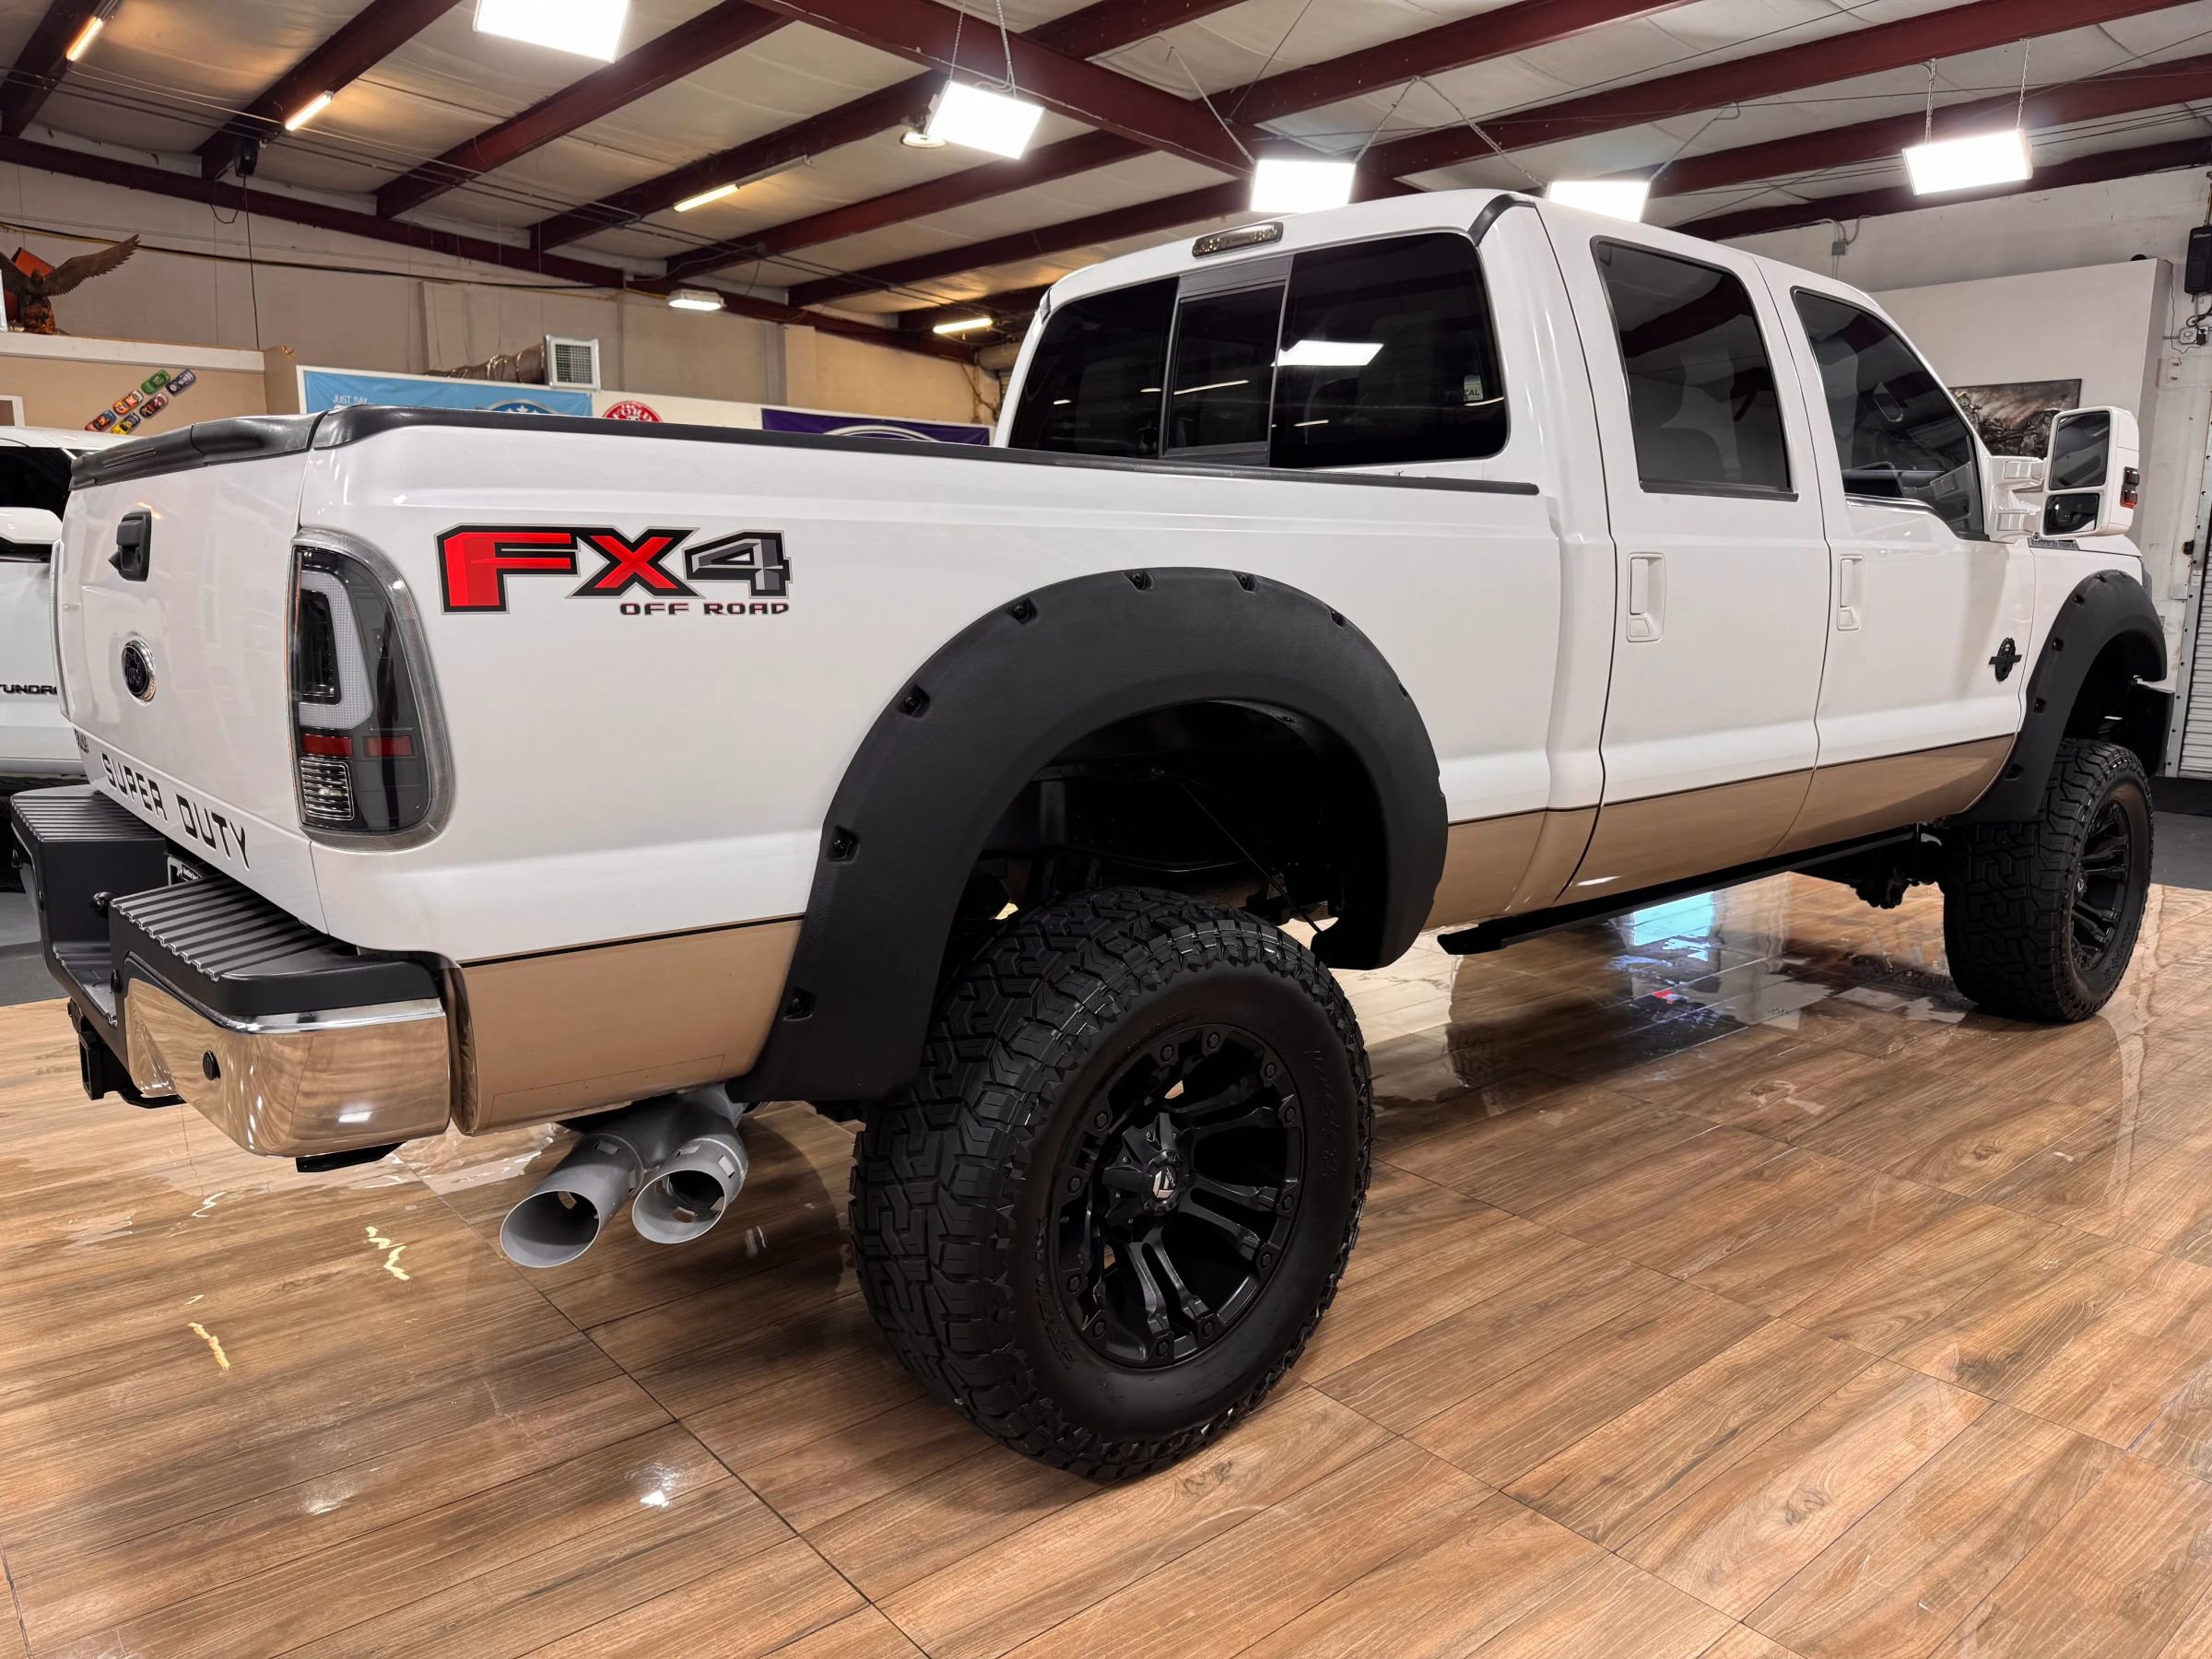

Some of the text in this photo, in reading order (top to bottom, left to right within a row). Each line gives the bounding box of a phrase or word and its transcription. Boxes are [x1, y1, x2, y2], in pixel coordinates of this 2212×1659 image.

[333, 394, 350, 404] JUST
[434, 523, 793, 615] FX4
[619, 602, 791, 617] OFF ROAD
[101, 752, 249, 871] SUPER DUTY
